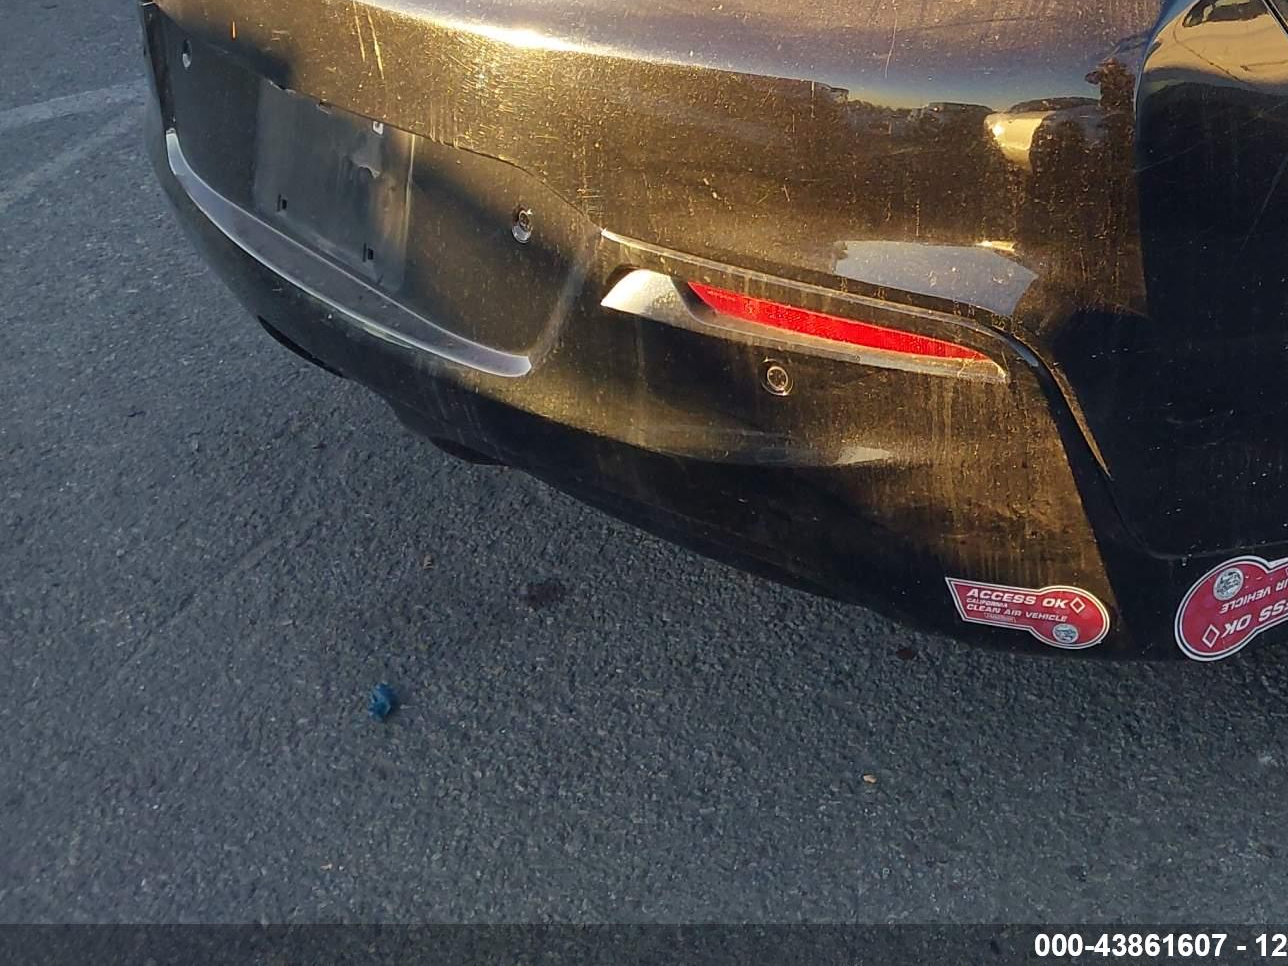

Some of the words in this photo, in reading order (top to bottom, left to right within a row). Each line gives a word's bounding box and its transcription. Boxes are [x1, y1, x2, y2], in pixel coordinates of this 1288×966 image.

[966, 588, 1037, 605] ACCESS
[1042, 597, 1069, 609] OK
[966, 597, 1008, 608] CALIFORNIA
[1219, 586, 1271, 614] VEHICLE
[966, 604, 1001, 614] CLEAN
[1004, 608, 1022, 617] AIR
[1025, 612, 1068, 622] VEHICLE
[1220, 614, 1252, 638] OK
